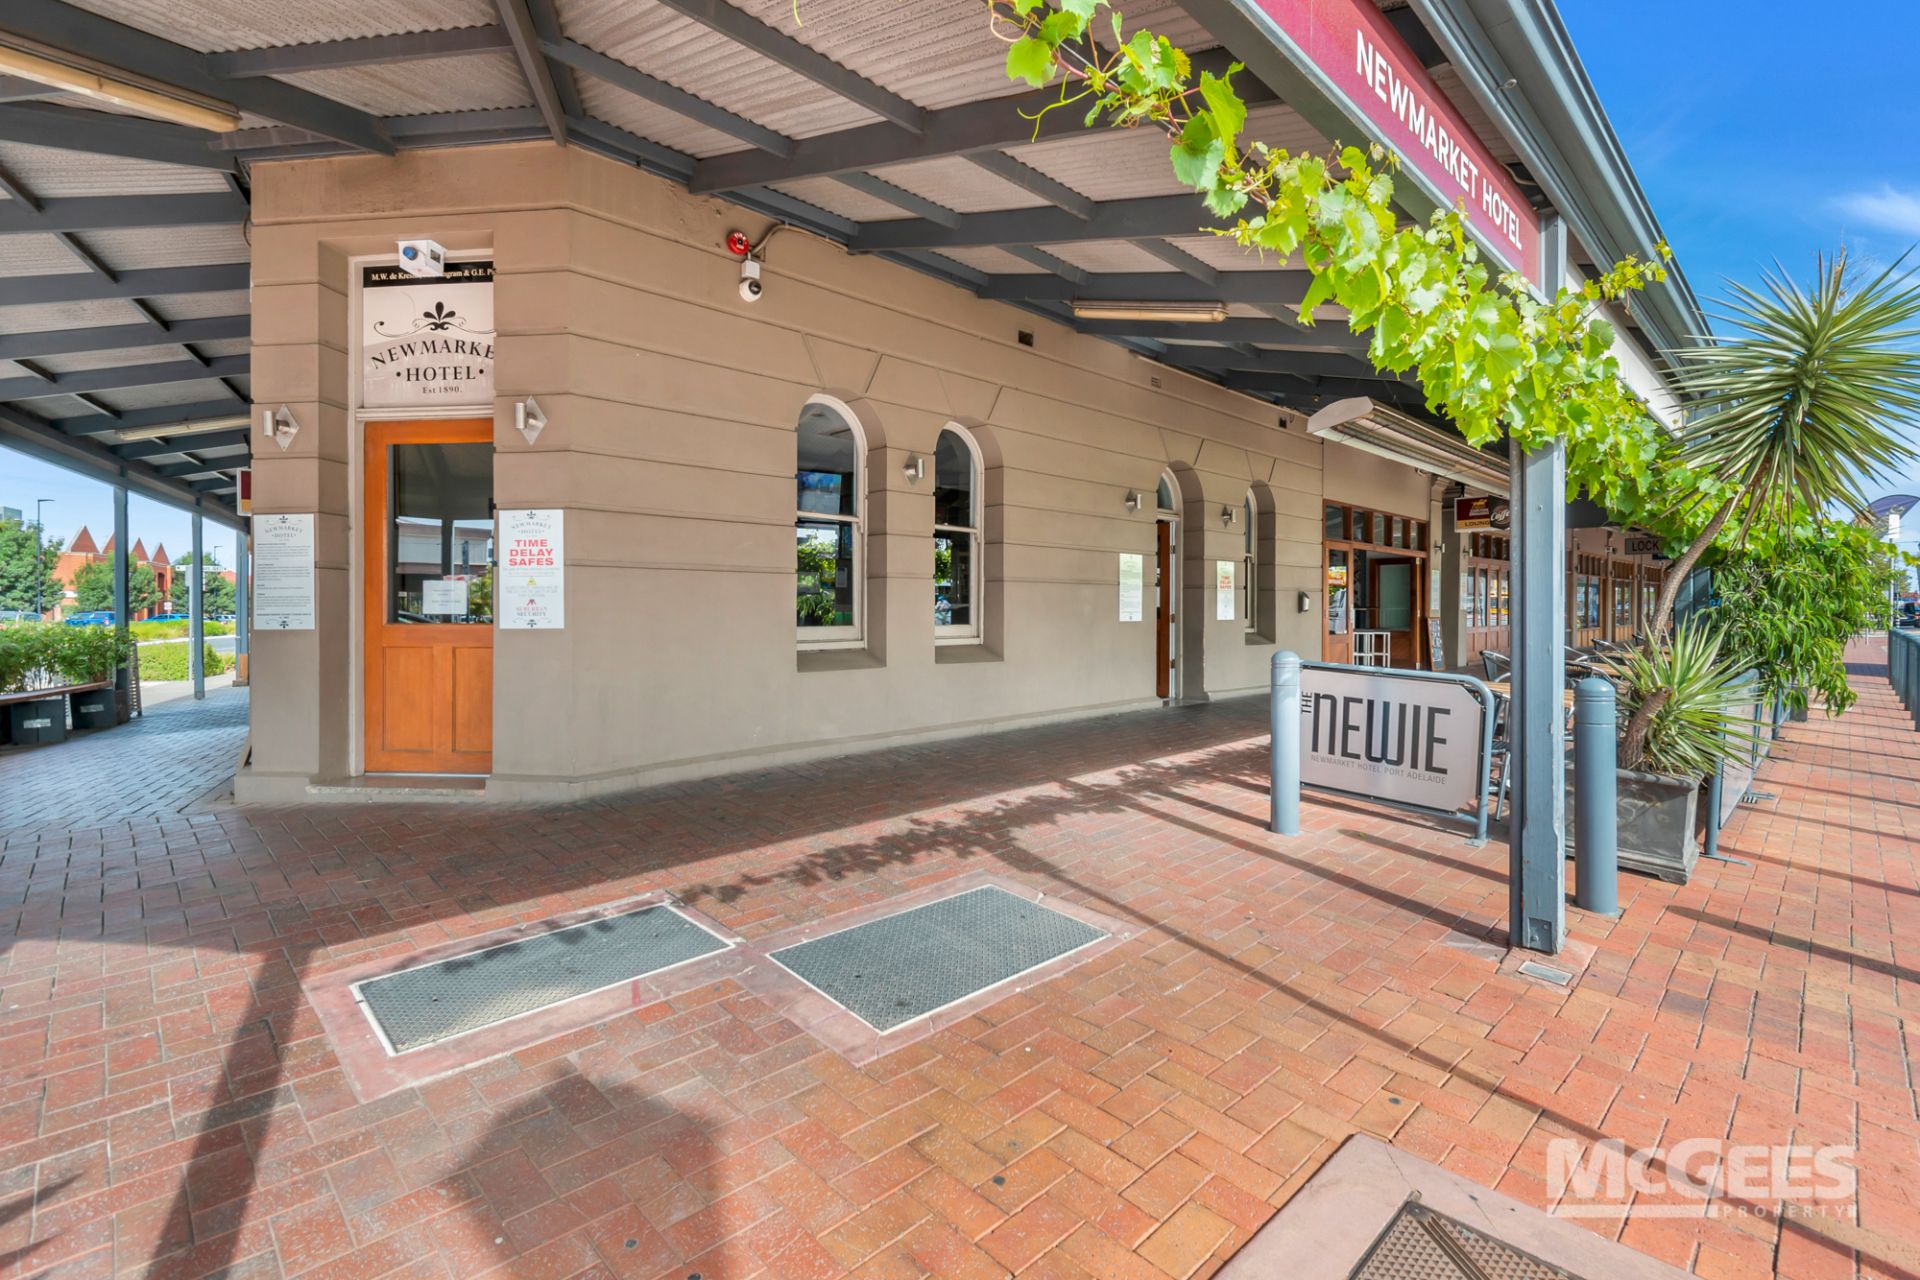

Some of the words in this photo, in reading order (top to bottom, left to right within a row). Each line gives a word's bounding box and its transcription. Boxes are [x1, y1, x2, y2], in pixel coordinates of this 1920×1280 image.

[1356, 29, 1478, 200] NEWMARKET
[1482, 177, 1522, 250] HOTEL
[370, 339, 495, 370] NEWMARKE
[406, 365, 476, 382] HOTEL
[509, 548, 554, 557] DELAY
[514, 539, 548, 548] TIME
[508, 557, 554, 567] SAFES
[1301, 690, 1313, 715] THE
[1311, 754, 1355, 769] NEWMARKET
[1357, 762, 1382, 774] HOTEL
[1384, 766, 1404, 777] PORT
[1406, 770, 1447, 785] ADELAIDE
